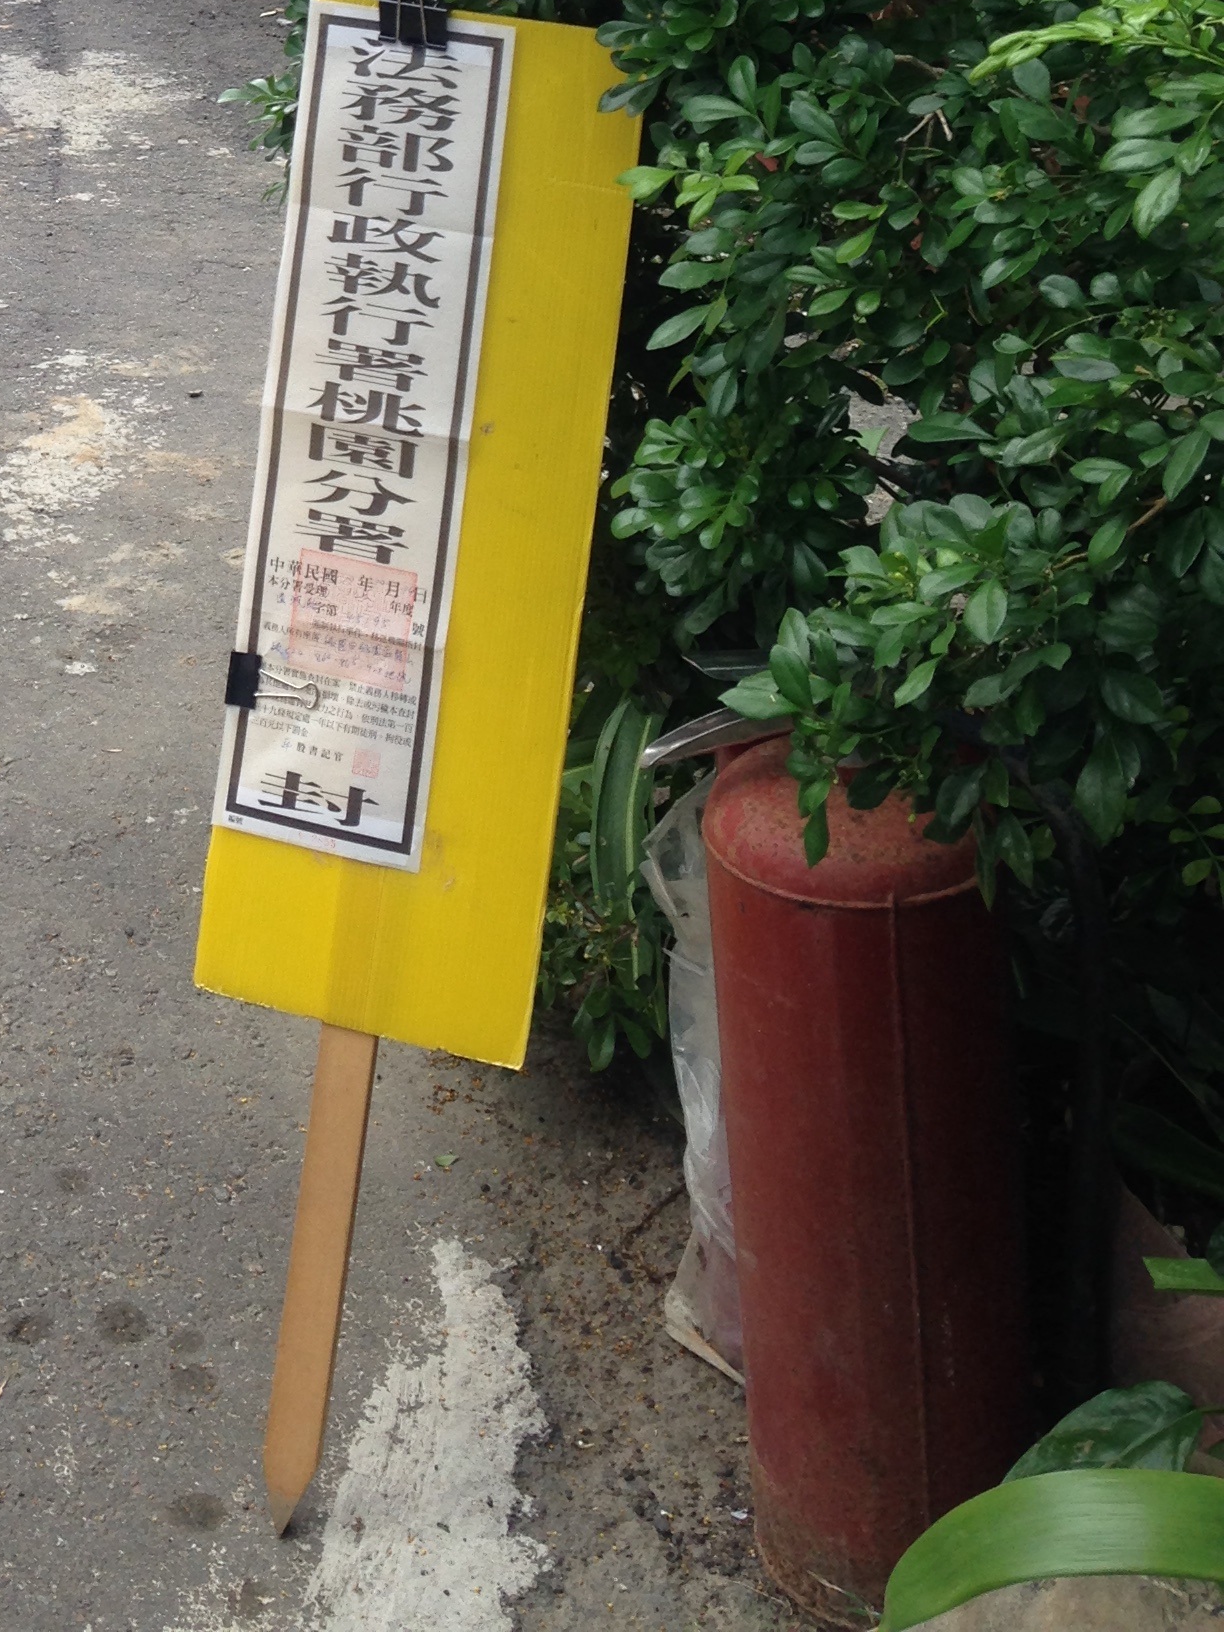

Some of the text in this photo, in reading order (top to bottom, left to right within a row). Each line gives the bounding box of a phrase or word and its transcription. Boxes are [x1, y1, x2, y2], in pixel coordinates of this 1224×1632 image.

[294, 36, 463, 565] 法務部行政執行署桃園分署
[257, 771, 379, 827] 封
